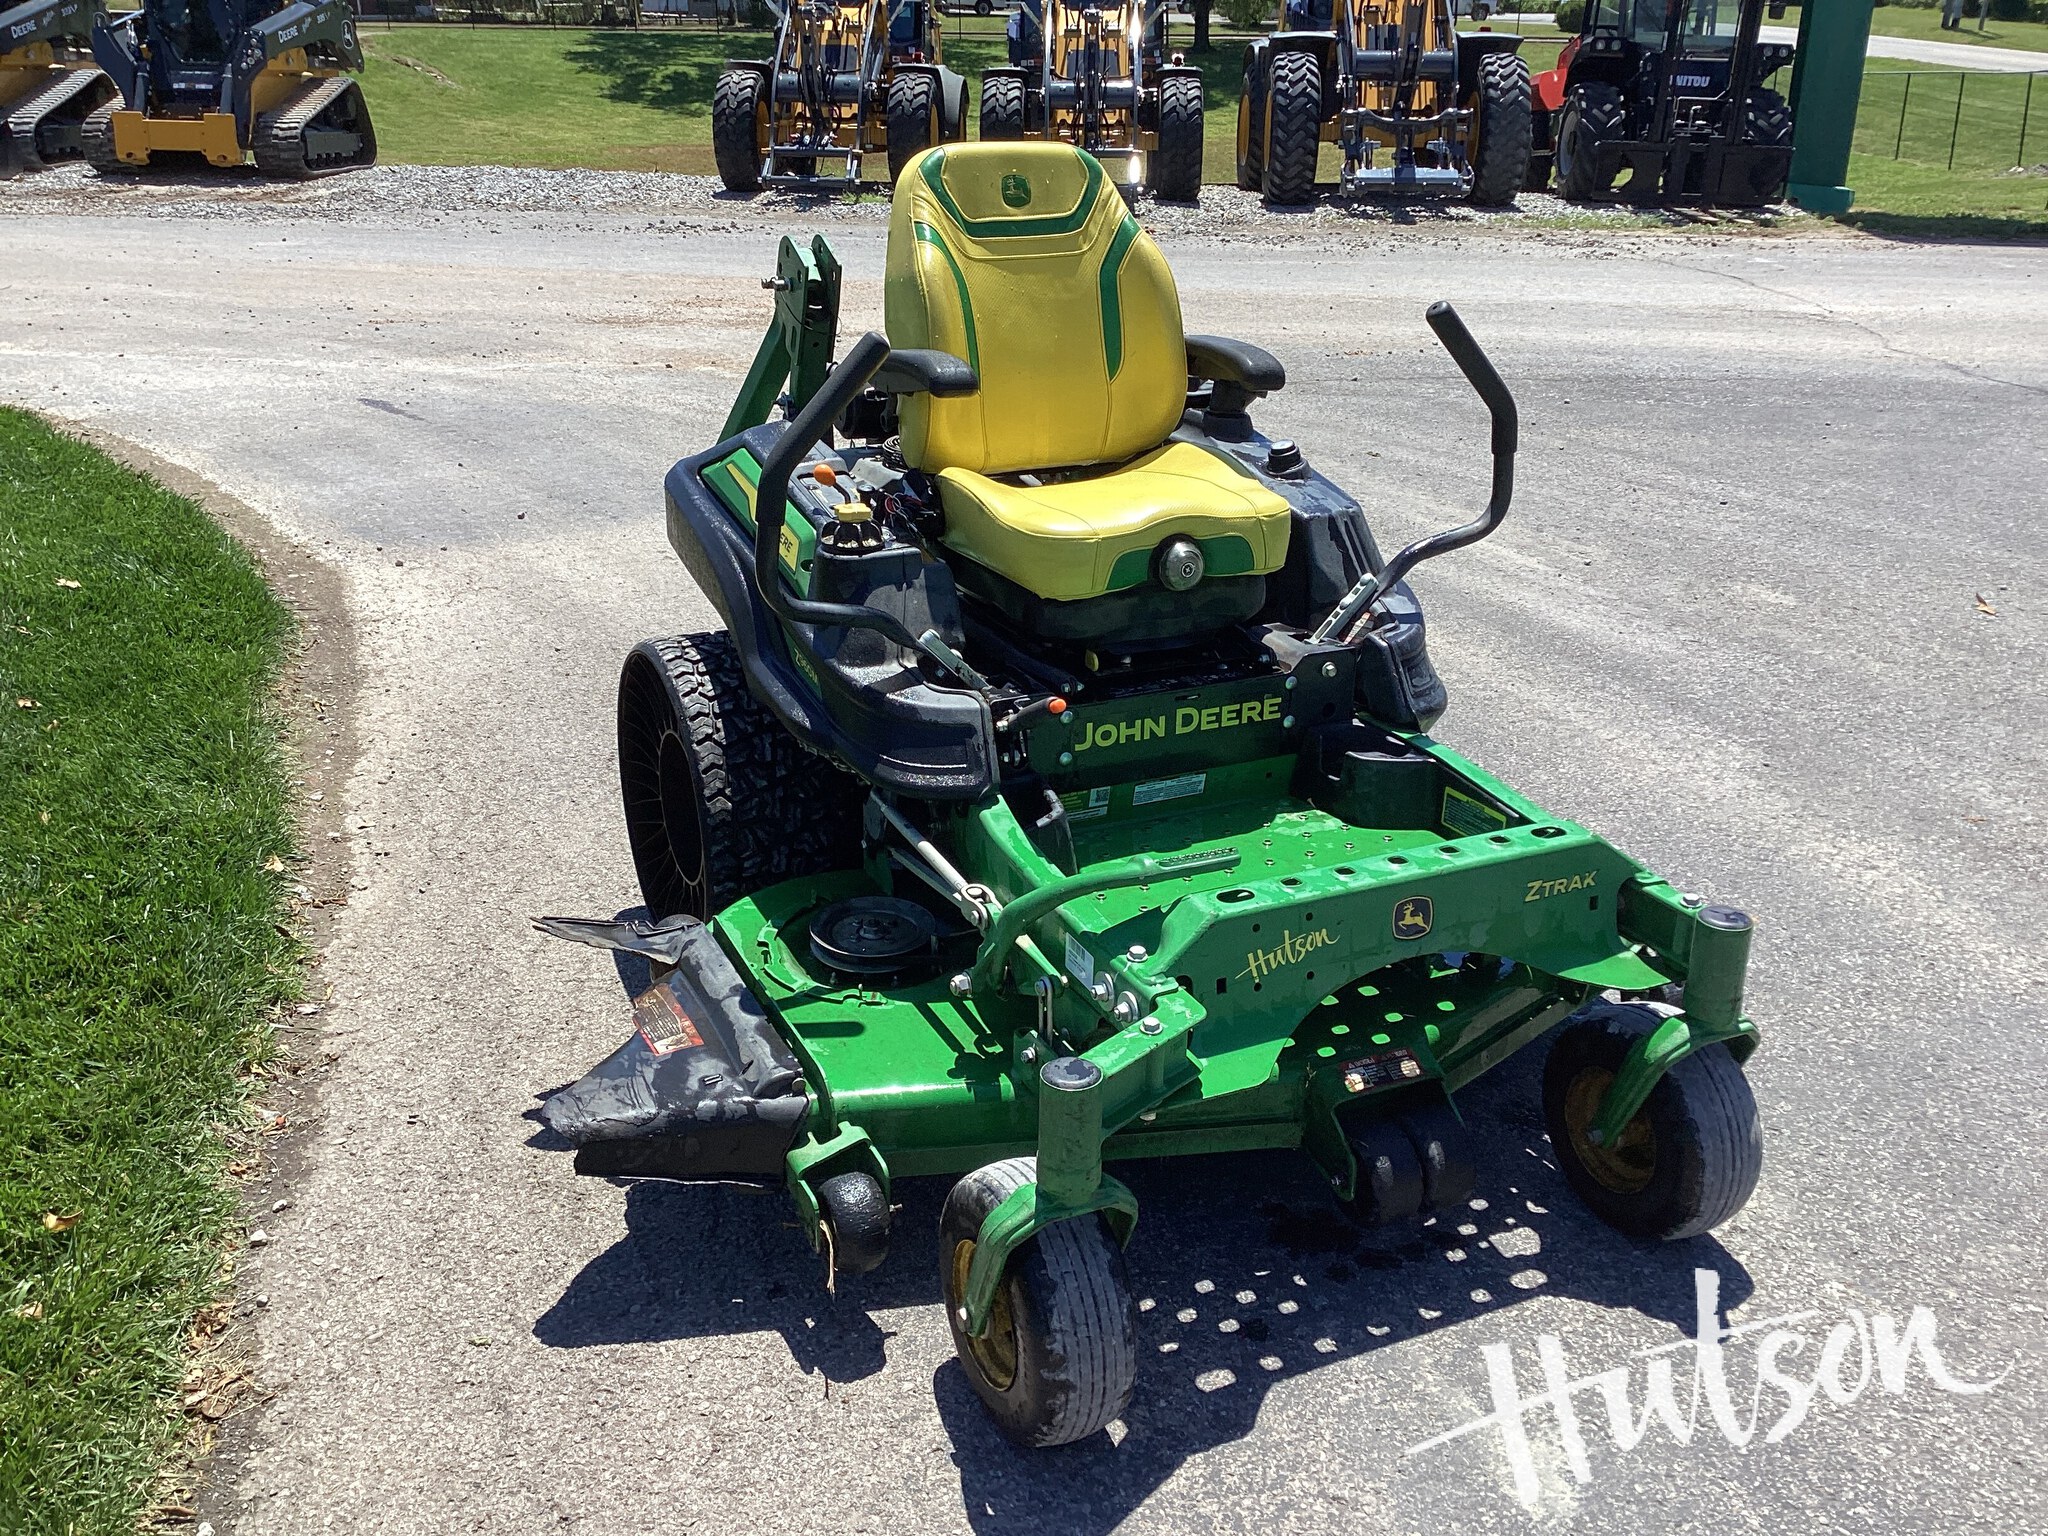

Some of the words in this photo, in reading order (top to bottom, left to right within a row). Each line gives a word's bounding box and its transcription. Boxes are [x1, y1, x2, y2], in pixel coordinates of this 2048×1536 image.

[11, 19, 37, 39] DEERE
[278, 25, 299, 44] DEERE
[1669, 75, 1711, 87] NITOU
[780, 532, 793, 553] ERE
[1074, 715, 1166, 751] JOHN
[1175, 697, 1282, 735] DEERE
[1524, 870, 1598, 902] ZTRAK
[1234, 928, 1341, 980] Hutson
